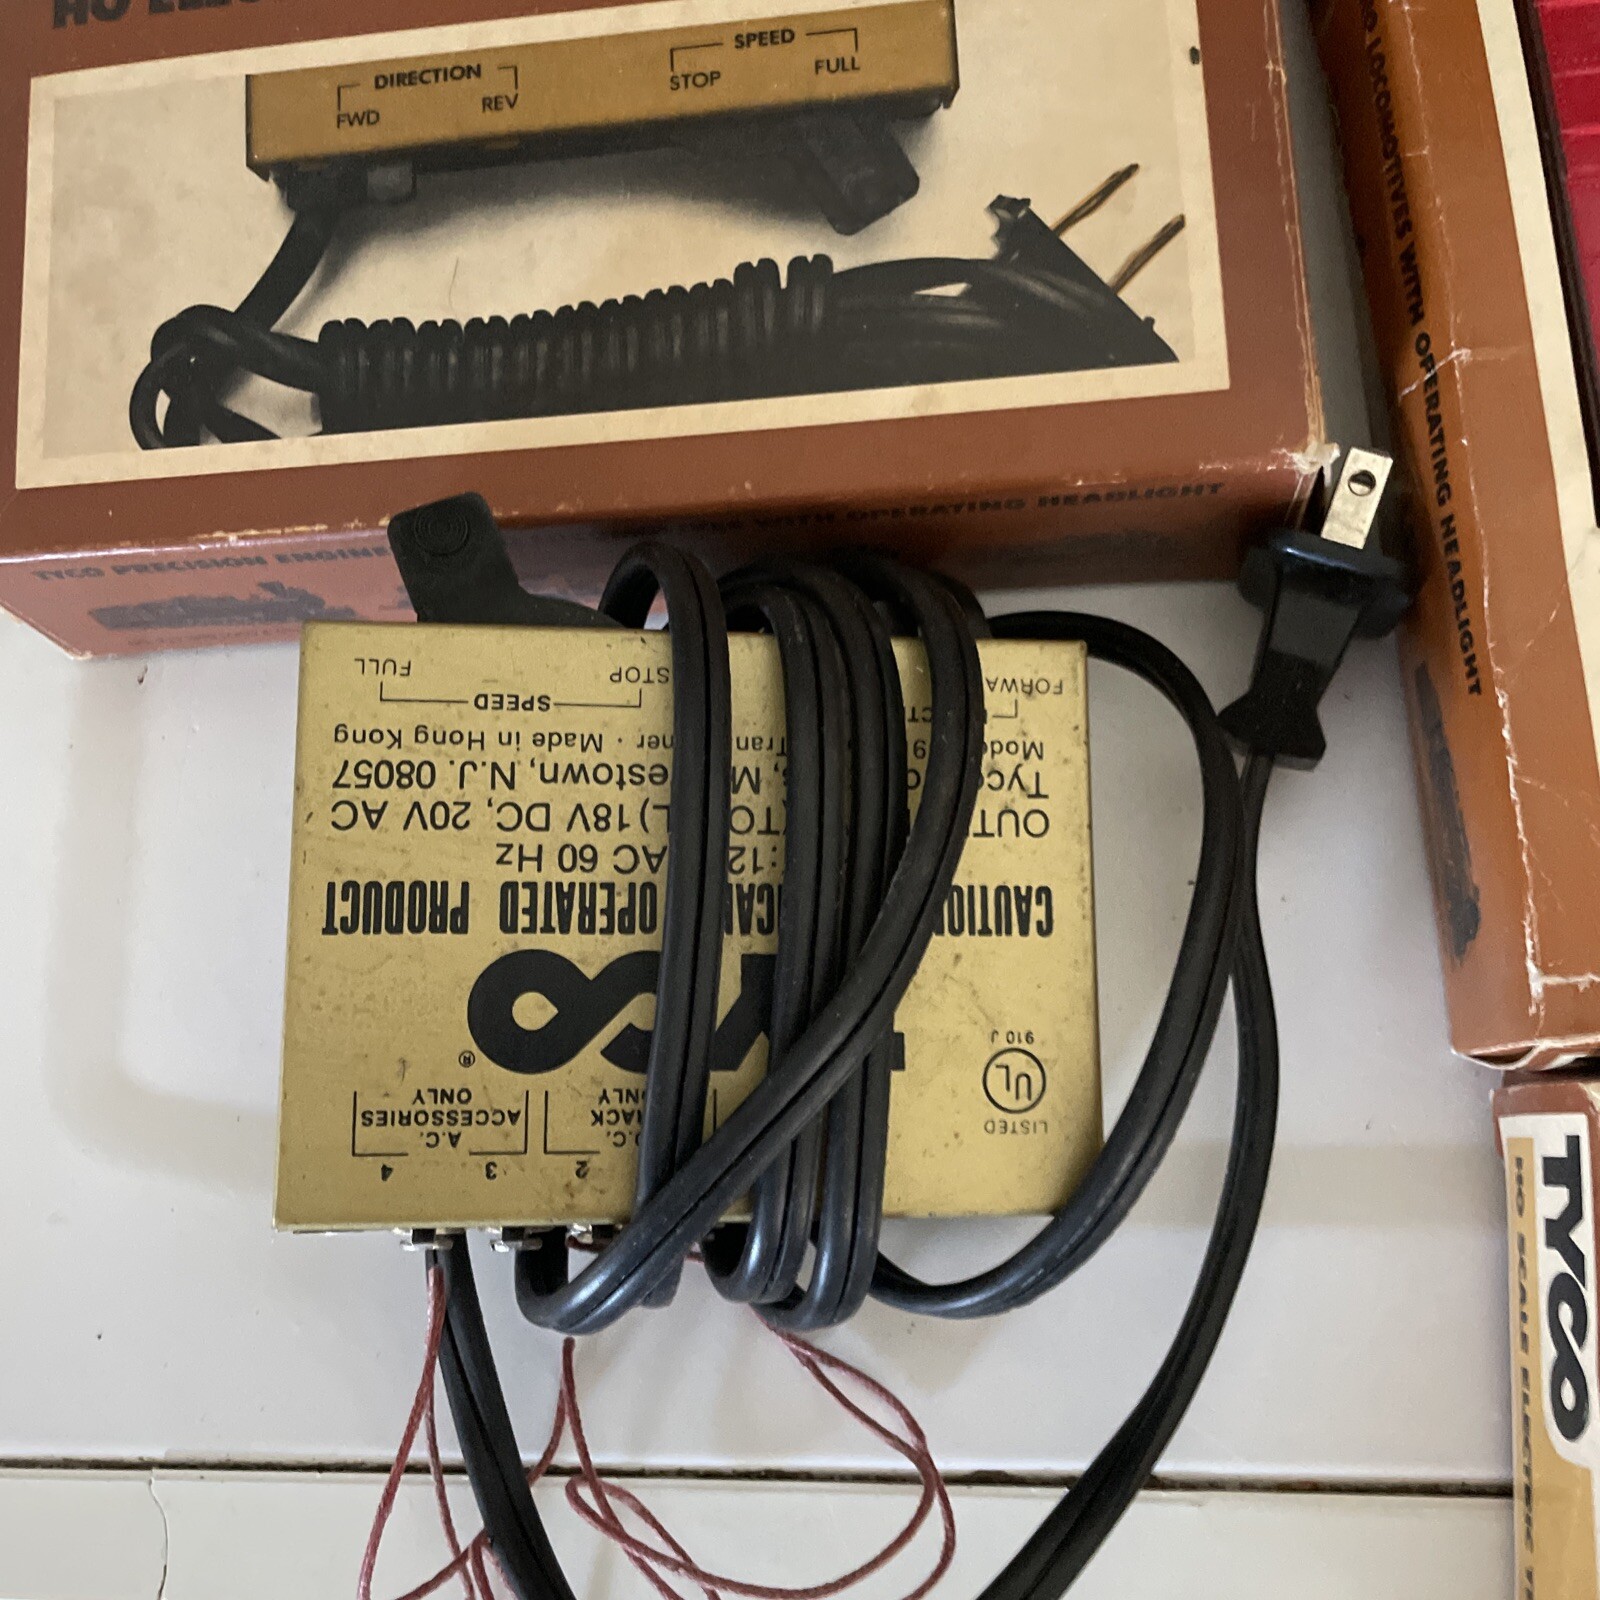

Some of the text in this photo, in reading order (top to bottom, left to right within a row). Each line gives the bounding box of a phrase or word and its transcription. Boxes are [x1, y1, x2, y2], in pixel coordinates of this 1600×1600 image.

[734, 28, 796, 50] SPEED
[814, 56, 861, 75] FULL
[373, 63, 483, 91] DIRECTION
[669, 71, 721, 91] STOP
[481, 93, 519, 113] REV
[336, 108, 381, 129] FWD
[1400, 240, 1424, 327] WITH
[1414, 332, 1453, 507] OPERATING
[1439, 513, 1482, 697] HEADLIGHT
[846, 497, 1027, 521] OPERATING
[1036, 481, 1226, 508] HEADLIGHT
[32, 545, 392, 581] TYCO PRECISION ENGINE
[354, 657, 412, 677] FULL
[609, 666, 670, 684] STOP
[985, 676, 1063, 695] FORWA
[473, 693, 551, 712] SPEED
[333, 723, 402, 749] Kong
[413, 725, 486, 751] Hong
[497, 731, 521, 752] in
[531, 732, 603, 753] Made
[981, 740, 1044, 761] Mod
[332, 758, 437, 789] 08057
[449, 758, 516, 790] N.J.
[530, 757, 761, 795] Mestown,
[979, 762, 1050, 800] Tyc
[331, 799, 389, 831] AC
[402, 800, 471, 832] 20V
[486, 797, 551, 833] DC,
[566, 801, 629, 833] 18V
[970, 808, 1050, 838] OUT
[495, 842, 668, 875] AC 60 Hz
[321, 879, 1055, 938] CAUTIO OPERATED PRODUCT
[1006, 1030, 1035, 1045] 910
[412, 1087, 473, 1106] ONLY
[597, 1087, 645, 1105] NLY
[360, 1108, 522, 1127] ACCESSORIES
[590, 1108, 641, 1127] ACK
[983, 1119, 1049, 1135] LISTED
[419, 1130, 462, 1149] A.C.
[380, 1163, 394, 1183] 4
[484, 1160, 499, 1181] 3
[575, 1160, 591, 1179] 2
[1541, 1134, 1591, 1444] TYCO
